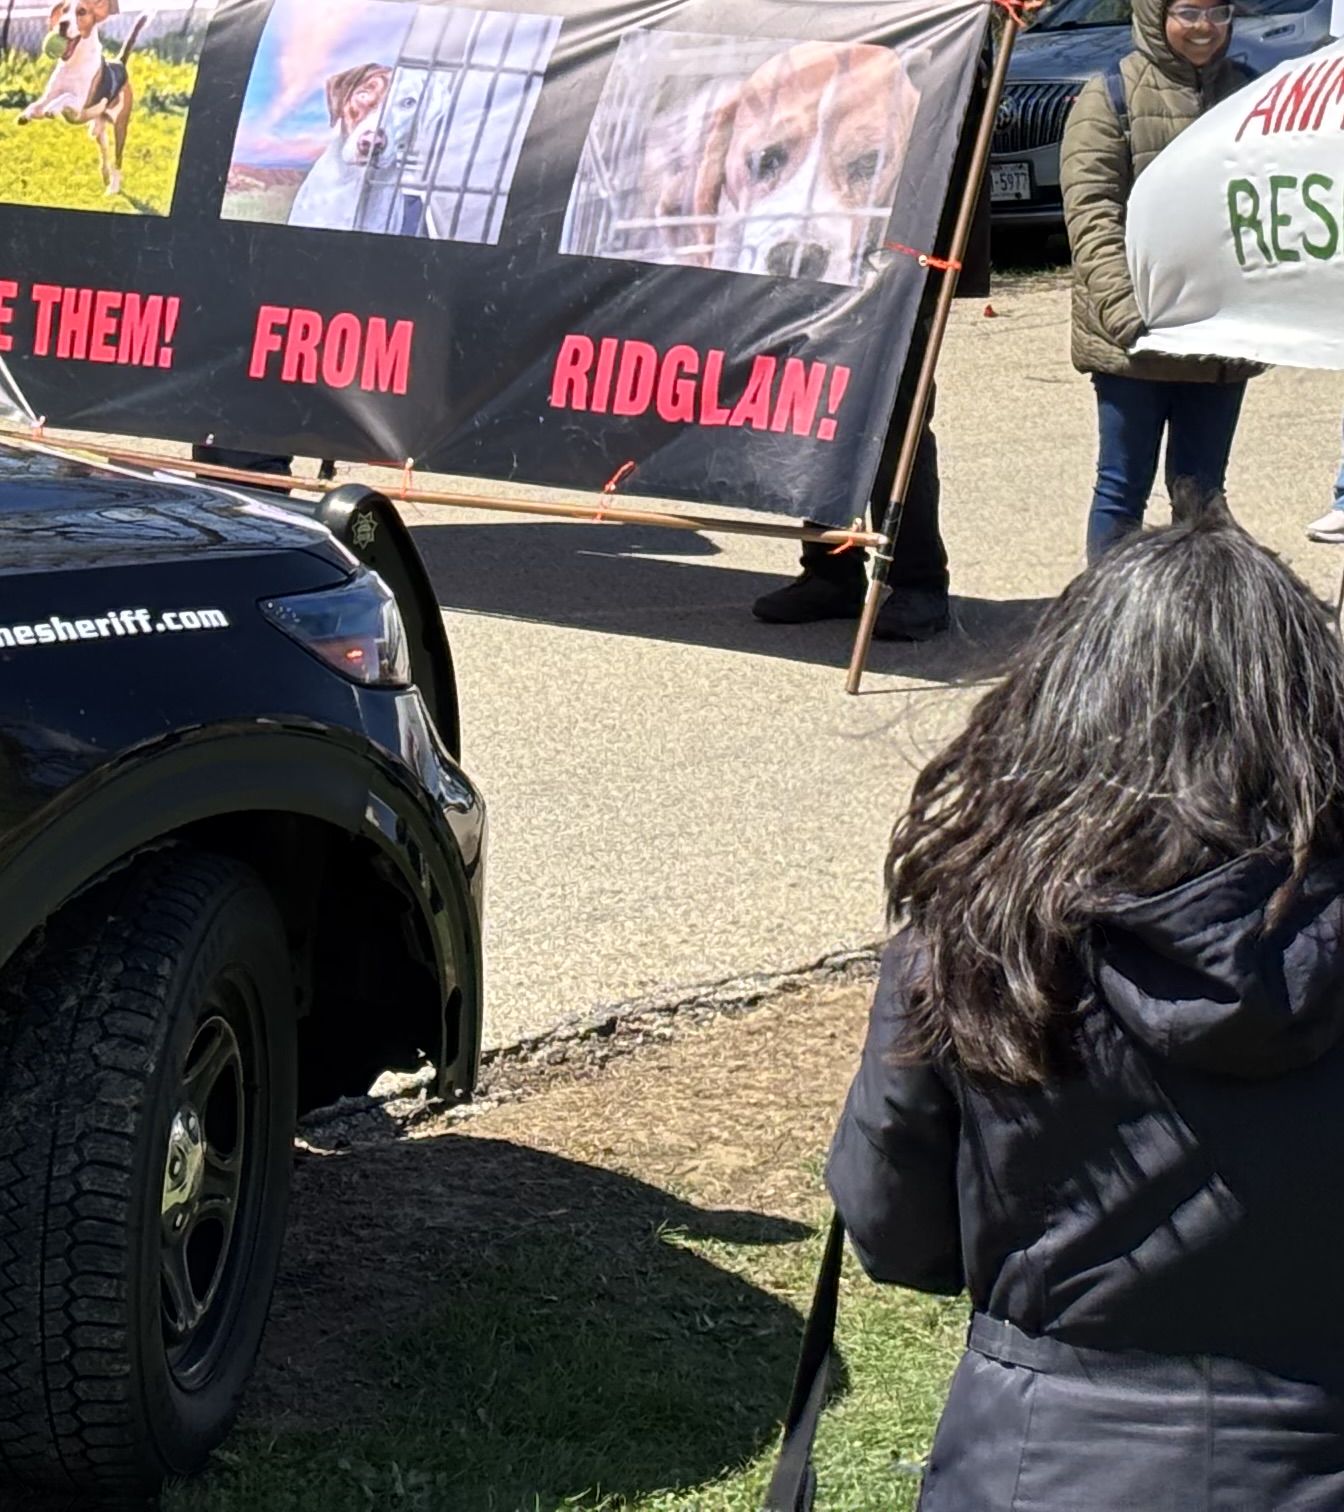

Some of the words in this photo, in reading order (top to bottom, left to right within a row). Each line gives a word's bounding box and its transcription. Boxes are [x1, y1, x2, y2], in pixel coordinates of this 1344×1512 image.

[32, 283, 180, 369] THEM!
[248, 304, 414, 395] FROM
[550, 334, 851, 442] RIDGLAN!
